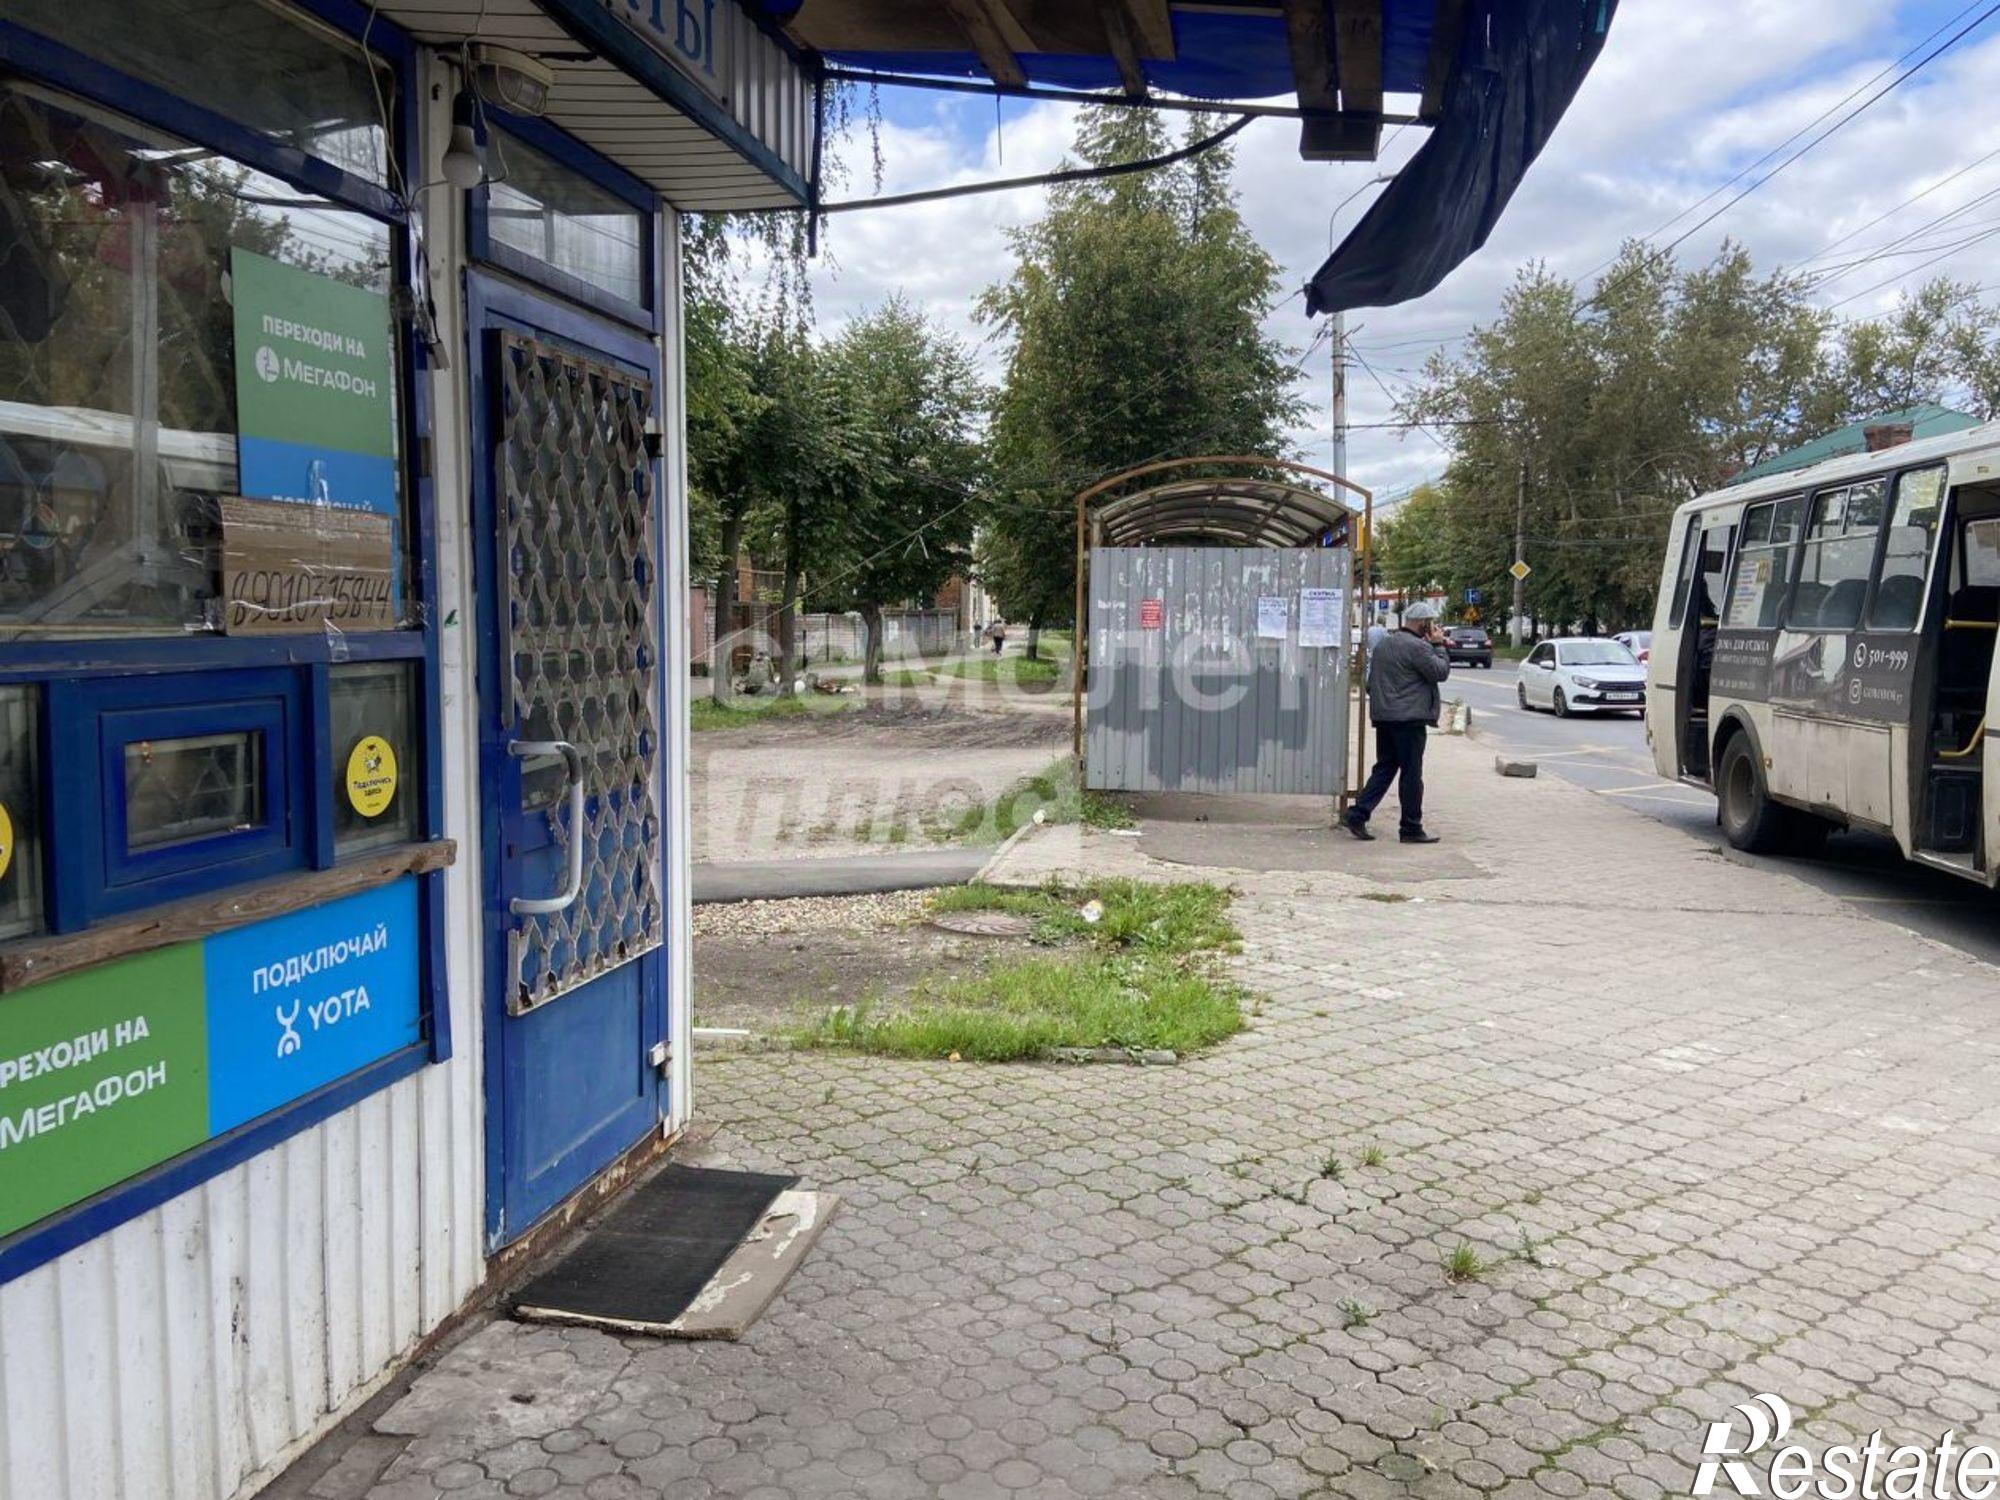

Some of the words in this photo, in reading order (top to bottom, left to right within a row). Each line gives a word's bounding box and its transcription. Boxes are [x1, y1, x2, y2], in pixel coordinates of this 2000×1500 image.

[262, 314, 342, 353] ПЕРЕХОДИ
[345, 337, 366, 359] НА
[1868, 649, 1908, 671] 501-999
[252, 921, 388, 995] ПОДКЛЮЧАЙ
[307, 985, 371, 1031] YOTA
[114, 1015, 150, 1047] НА
